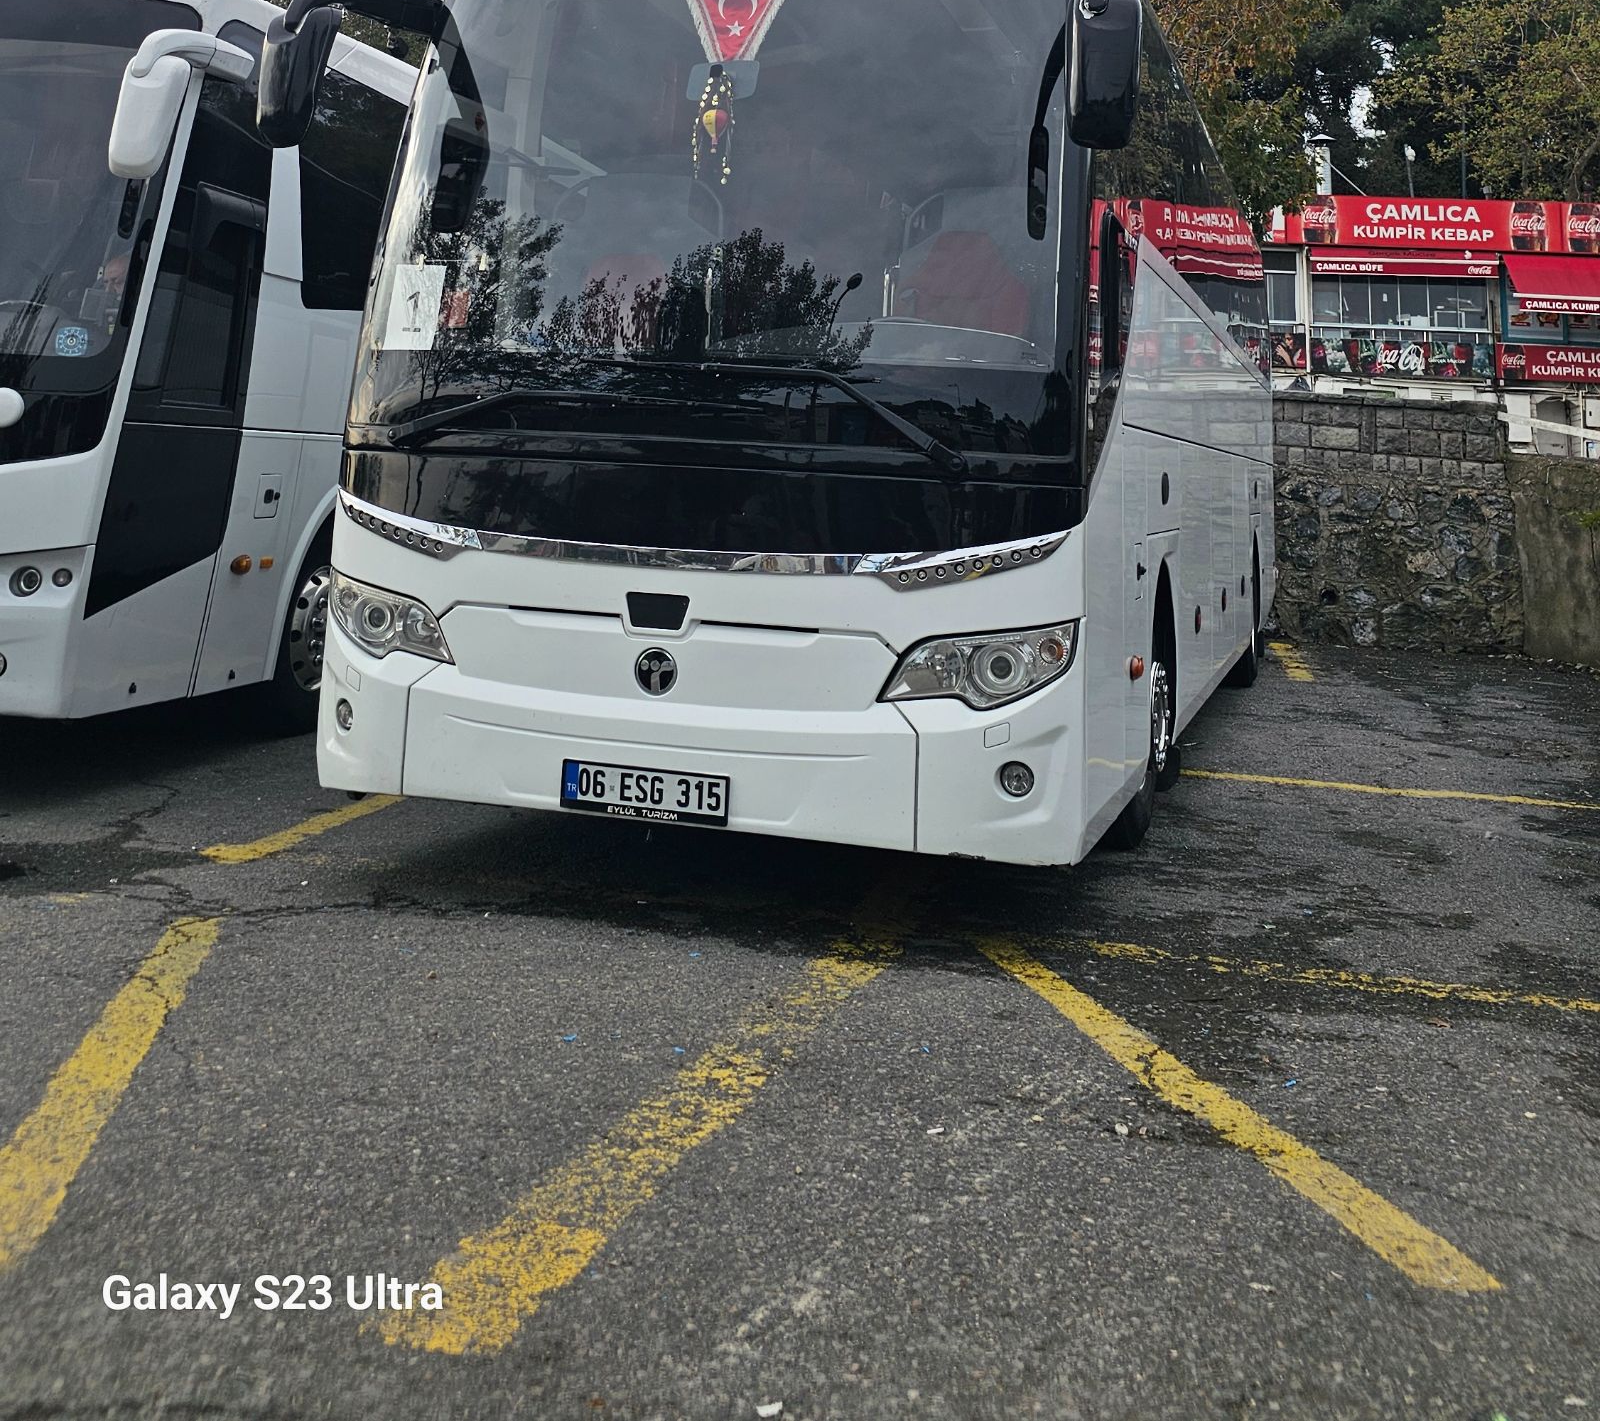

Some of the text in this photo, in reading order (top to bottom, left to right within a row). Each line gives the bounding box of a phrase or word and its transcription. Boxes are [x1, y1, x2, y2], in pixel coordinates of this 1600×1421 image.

[1366, 203, 1481, 223] ÇAMLICA
[1353, 224, 1495, 242] KUMPİR KEBAP
[1316, 262, 1384, 272] ÇAMLICA BÜFE
[402, 291, 421, 332] 1
[1525, 300, 1569, 310] ÇAMLICA
[1532, 364, 1585, 377] KUMPİR
[567, 782, 577, 793] TR
[578, 767, 721, 811] 06 ESG 315
[607, 805, 678, 821] EYLÜL TURİZM
